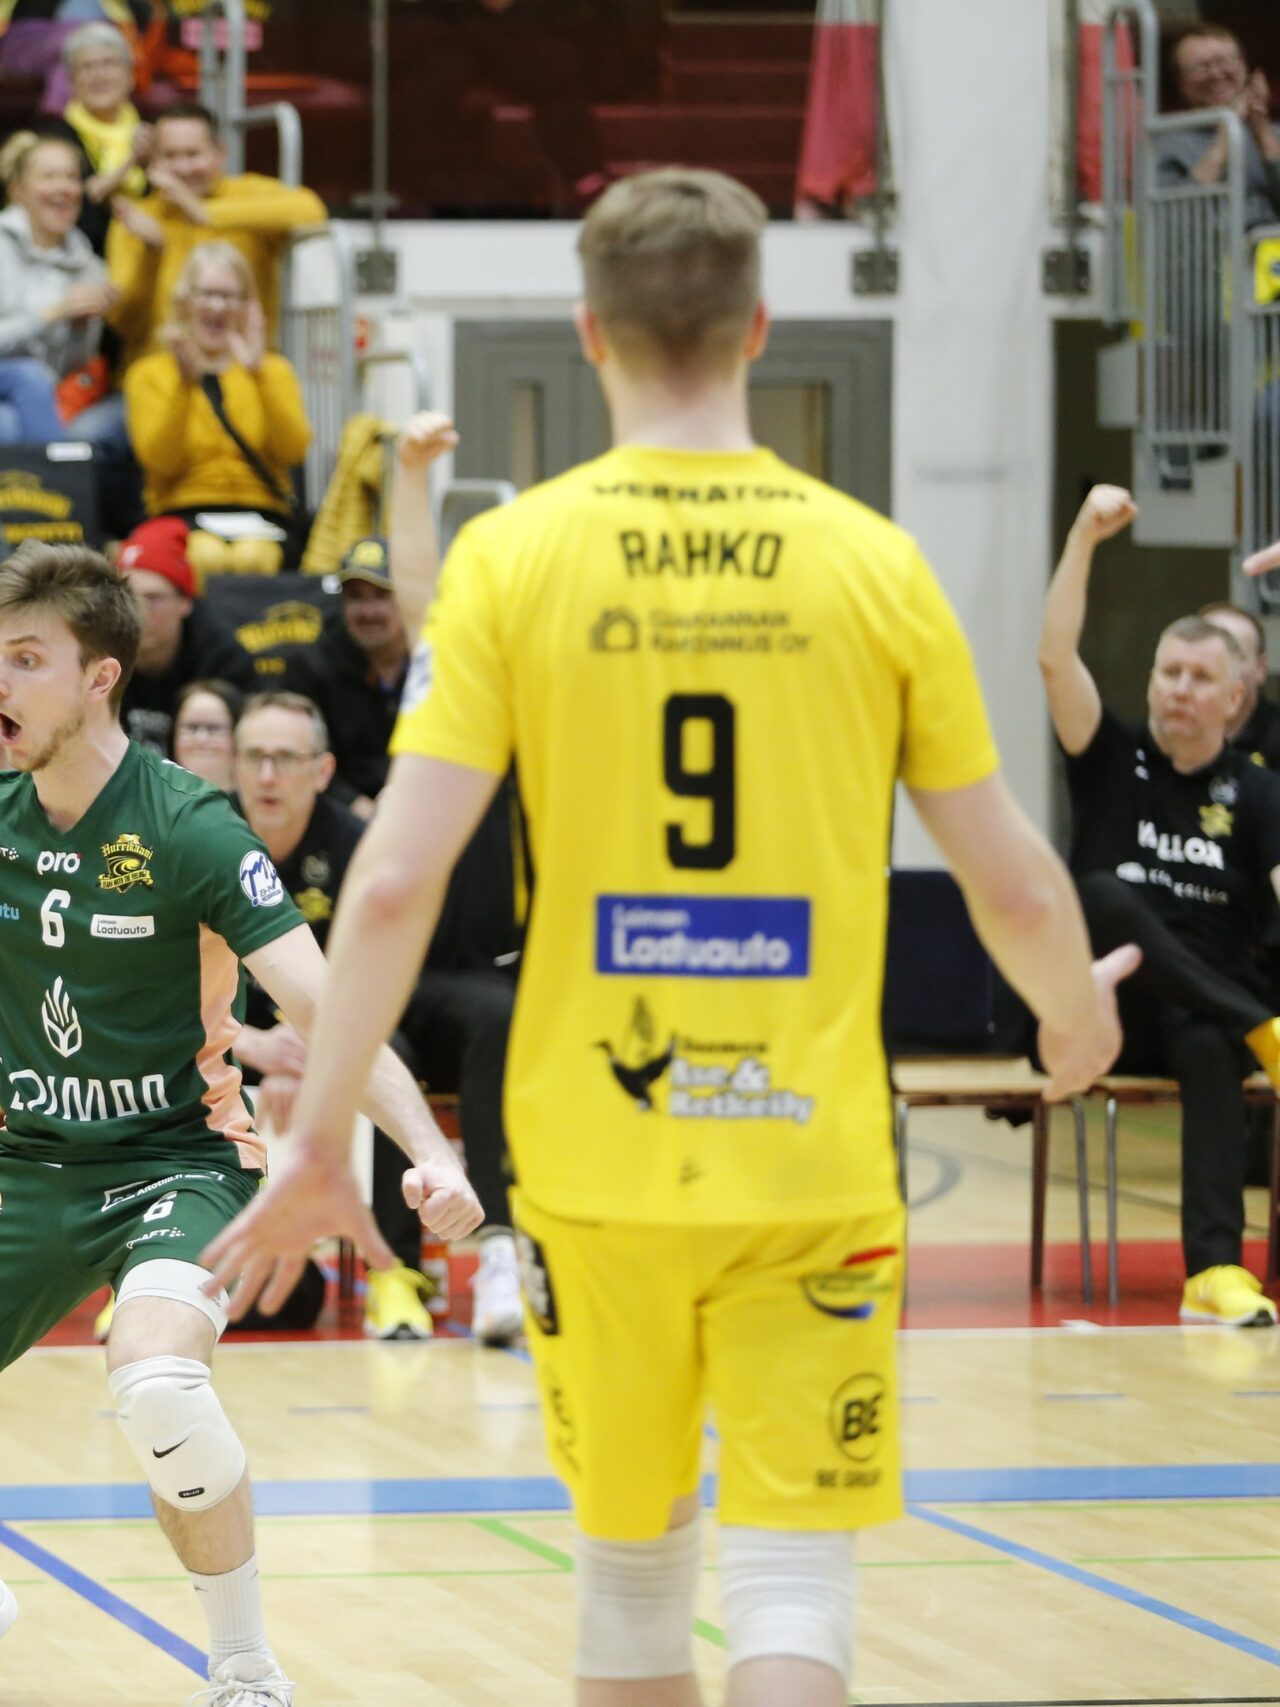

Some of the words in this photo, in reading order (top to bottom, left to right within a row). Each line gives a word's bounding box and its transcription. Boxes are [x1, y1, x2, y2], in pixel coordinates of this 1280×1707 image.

[619, 529, 784, 579] RAHKO
[663, 692, 736, 871] 9
[37, 850, 81, 876] pro
[101, 841, 154, 861] Hurrikaani
[40, 888, 71, 948] 6
[96, 924, 148, 935] Laatuauto
[143, 1191, 178, 1223] 6
[841, 1392, 884, 1441] BE
